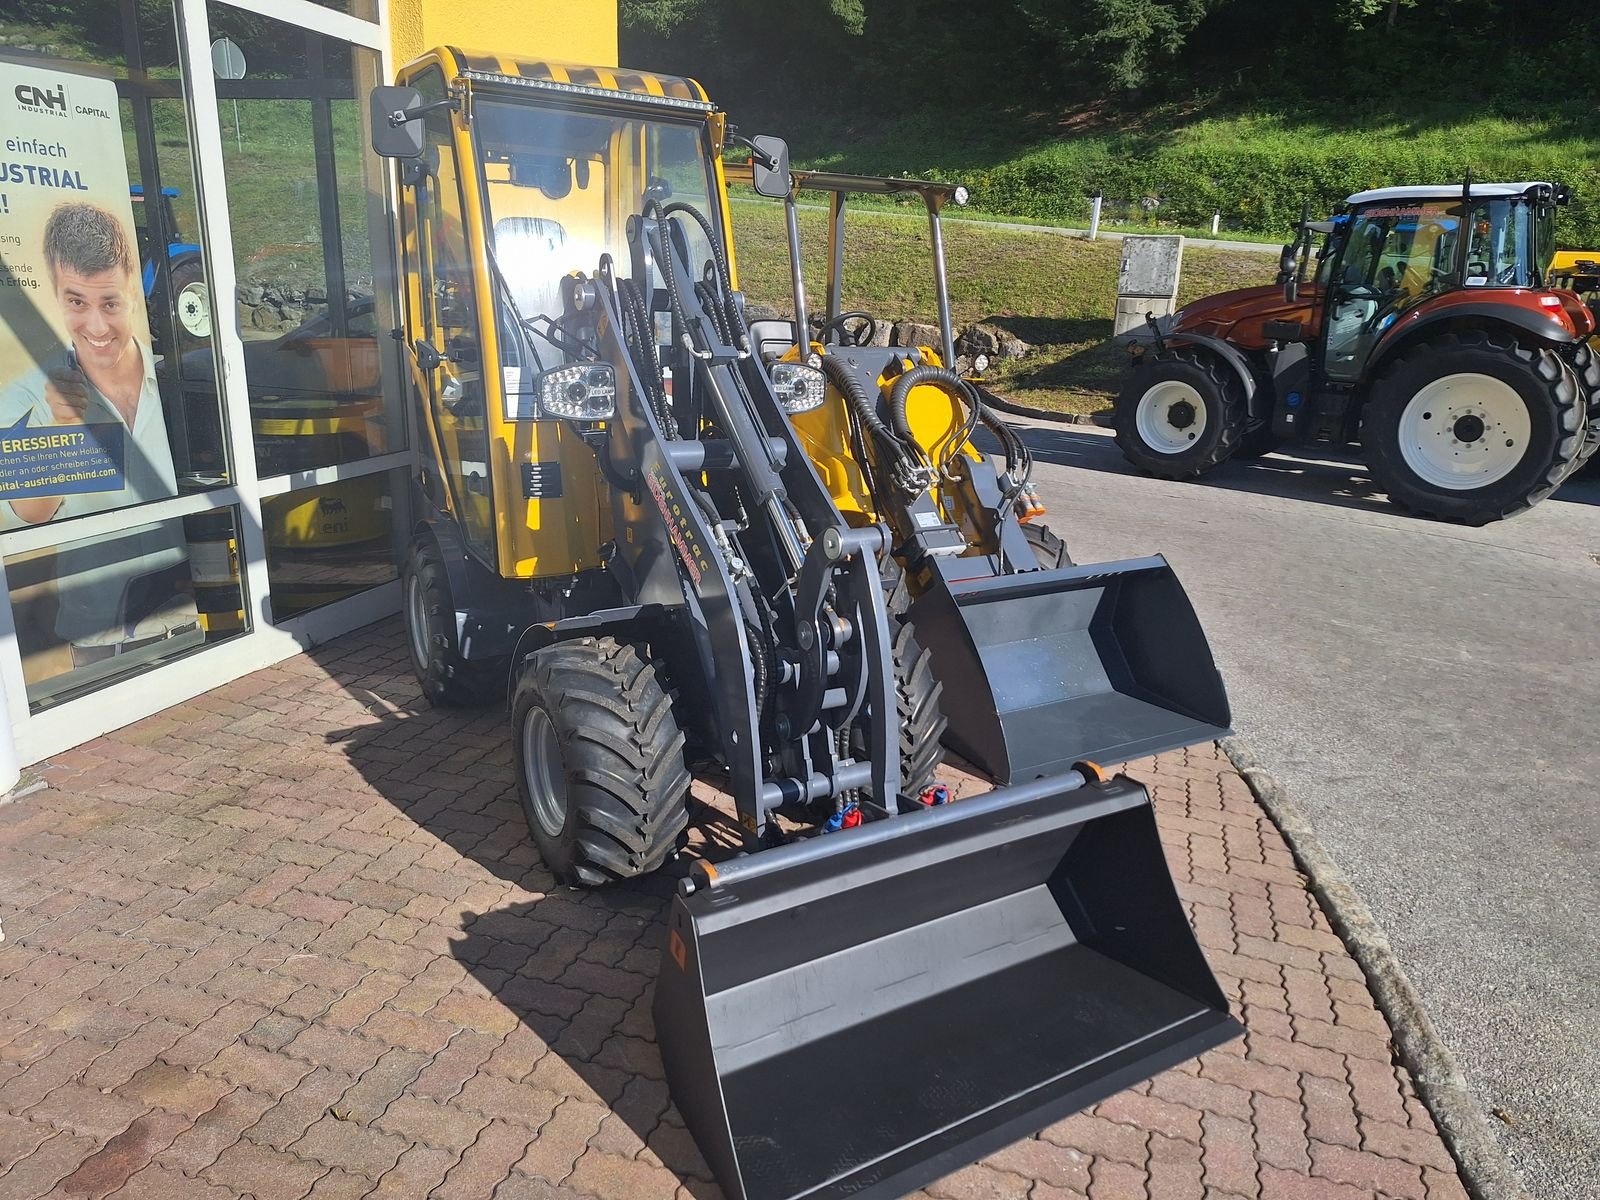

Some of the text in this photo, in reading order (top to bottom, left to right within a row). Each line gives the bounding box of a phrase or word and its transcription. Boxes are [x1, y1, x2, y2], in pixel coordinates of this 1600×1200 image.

[18, 105, 68, 117] INDUSTRIAL
[75, 106, 110, 119] CAPITAL
[6, 136, 67, 158] einfach
[0, 162, 88, 190] USTRIAL
[7, 277, 41, 289] Erfolg.
[0, 433, 85, 453] ERESSIERT?
[23, 454, 36, 462] Sie
[38, 452, 58, 460] Ihren
[60, 449, 78, 458] New
[32, 465, 49, 473] oder
[51, 460, 90, 470] schreiben
[91, 457, 102, 465] Sie
[652, 463, 709, 572] Eurotrac
